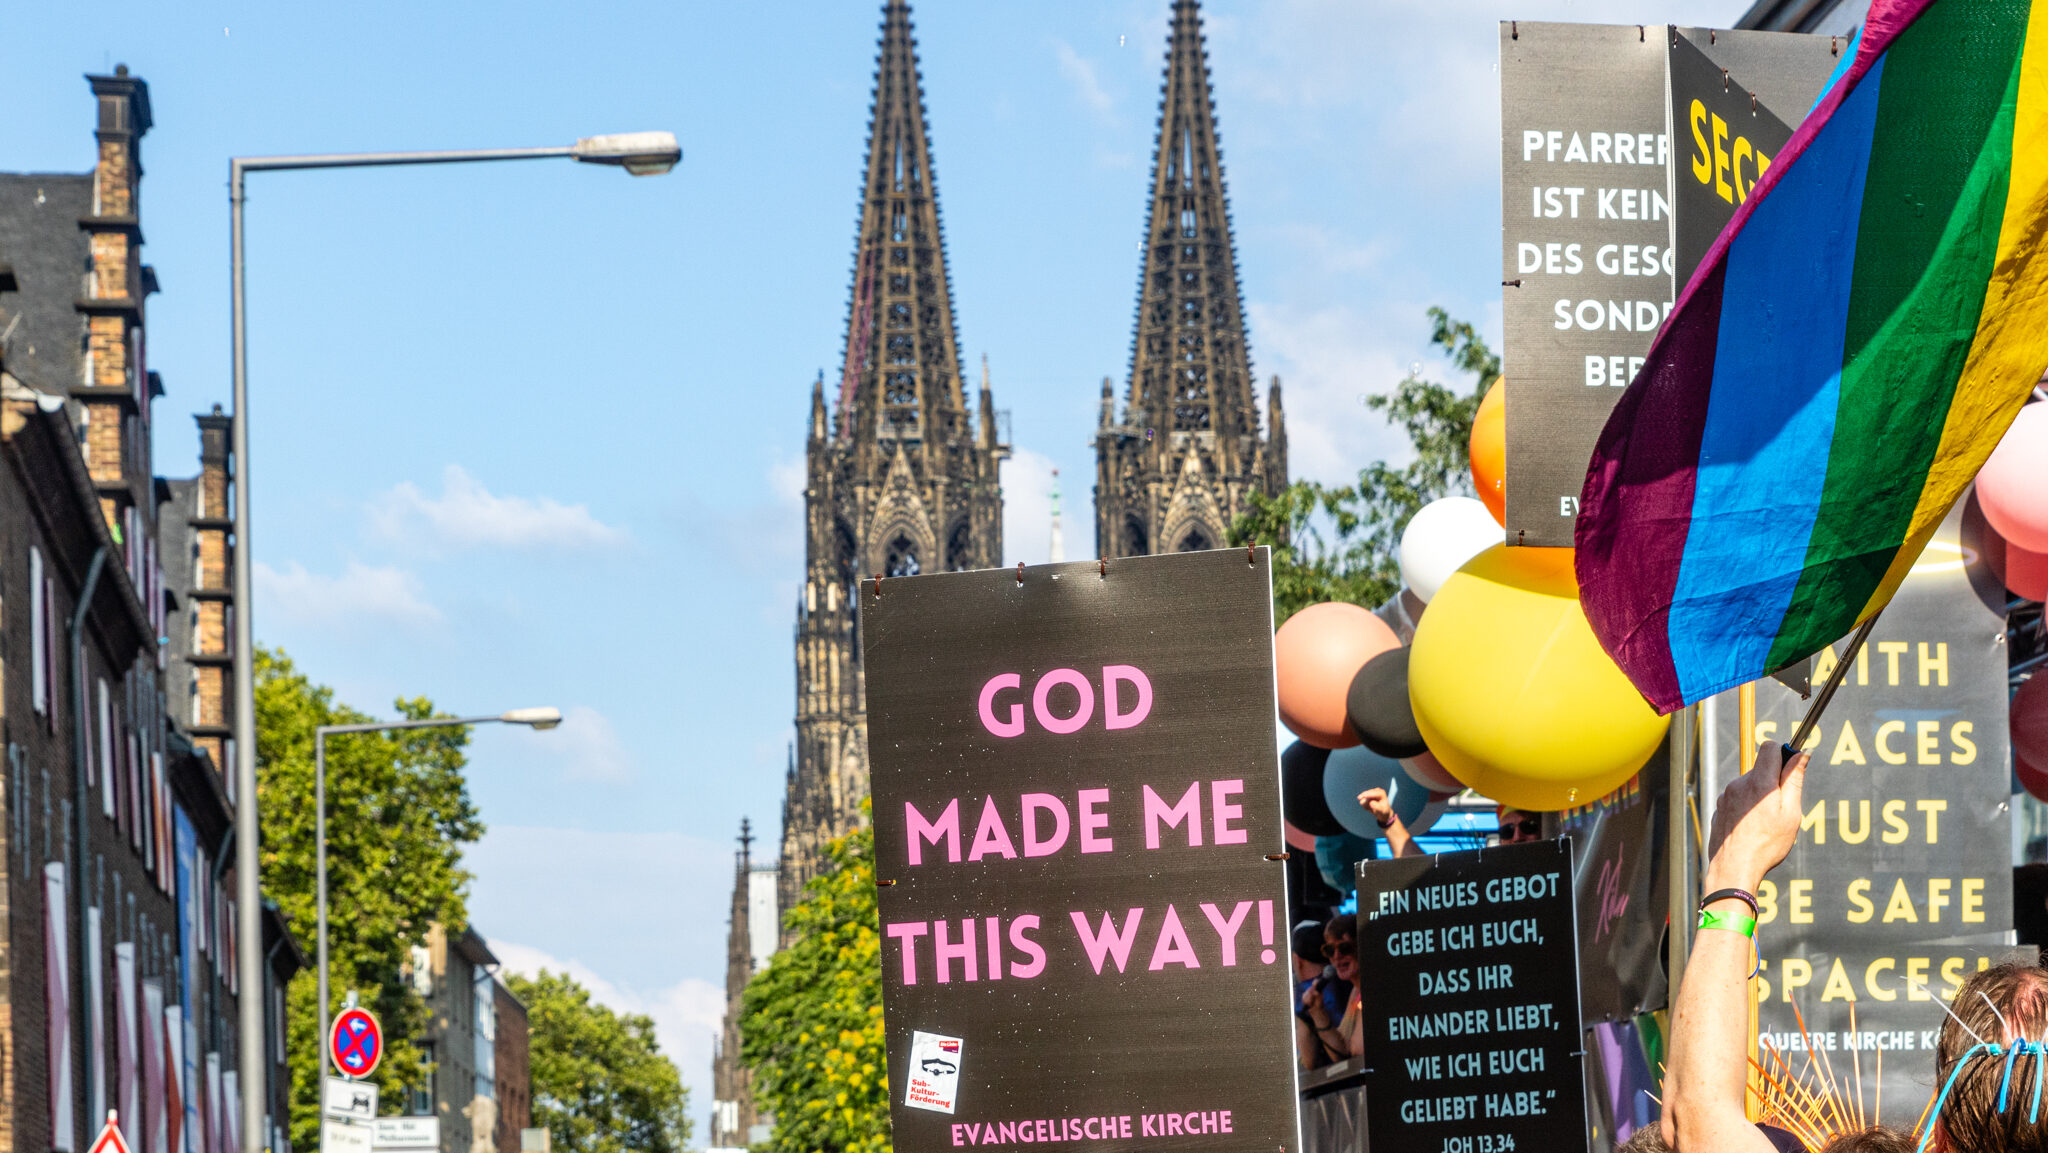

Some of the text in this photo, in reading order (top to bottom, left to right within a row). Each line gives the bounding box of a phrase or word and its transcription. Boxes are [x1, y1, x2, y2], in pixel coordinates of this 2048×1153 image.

[1533, 187, 1584, 218] IST
[1518, 243, 1583, 274] DES
[1811, 642, 1948, 686] AITH
[978, 665, 1153, 737] GOD
[905, 779, 1247, 865] MADE ME
[1417, 882, 1478, 911] NEUES
[1486, 873, 1559, 902] GEBOT
[1757, 879, 1814, 924] BE
[1848, 878, 1984, 923] SAFE
[887, 900, 1276, 985] THIS WAY!
[1388, 919, 1543, 956] GEBE ICH EUCH,
[1419, 965, 1513, 995] DASS IHR
[1390, 1004, 1558, 1040] EINANDER LIEBT,
[1758, 1031, 1837, 1051] QUEERE
[1843, 1031, 1913, 1050] KIRCHE
[1405, 1048, 1544, 1080] WIE ICH EUCH
[911, 1086, 940, 1096] Kultur-
[912, 1079, 931, 1087] Sub-
[910, 1094, 950, 1108] Förderung
[1401, 1096, 1477, 1123] GELIEBT
[952, 1111, 1232, 1146] EVANGELISCHE KIRCHE
[1442, 1134, 1515, 1153] JOH 13,34
